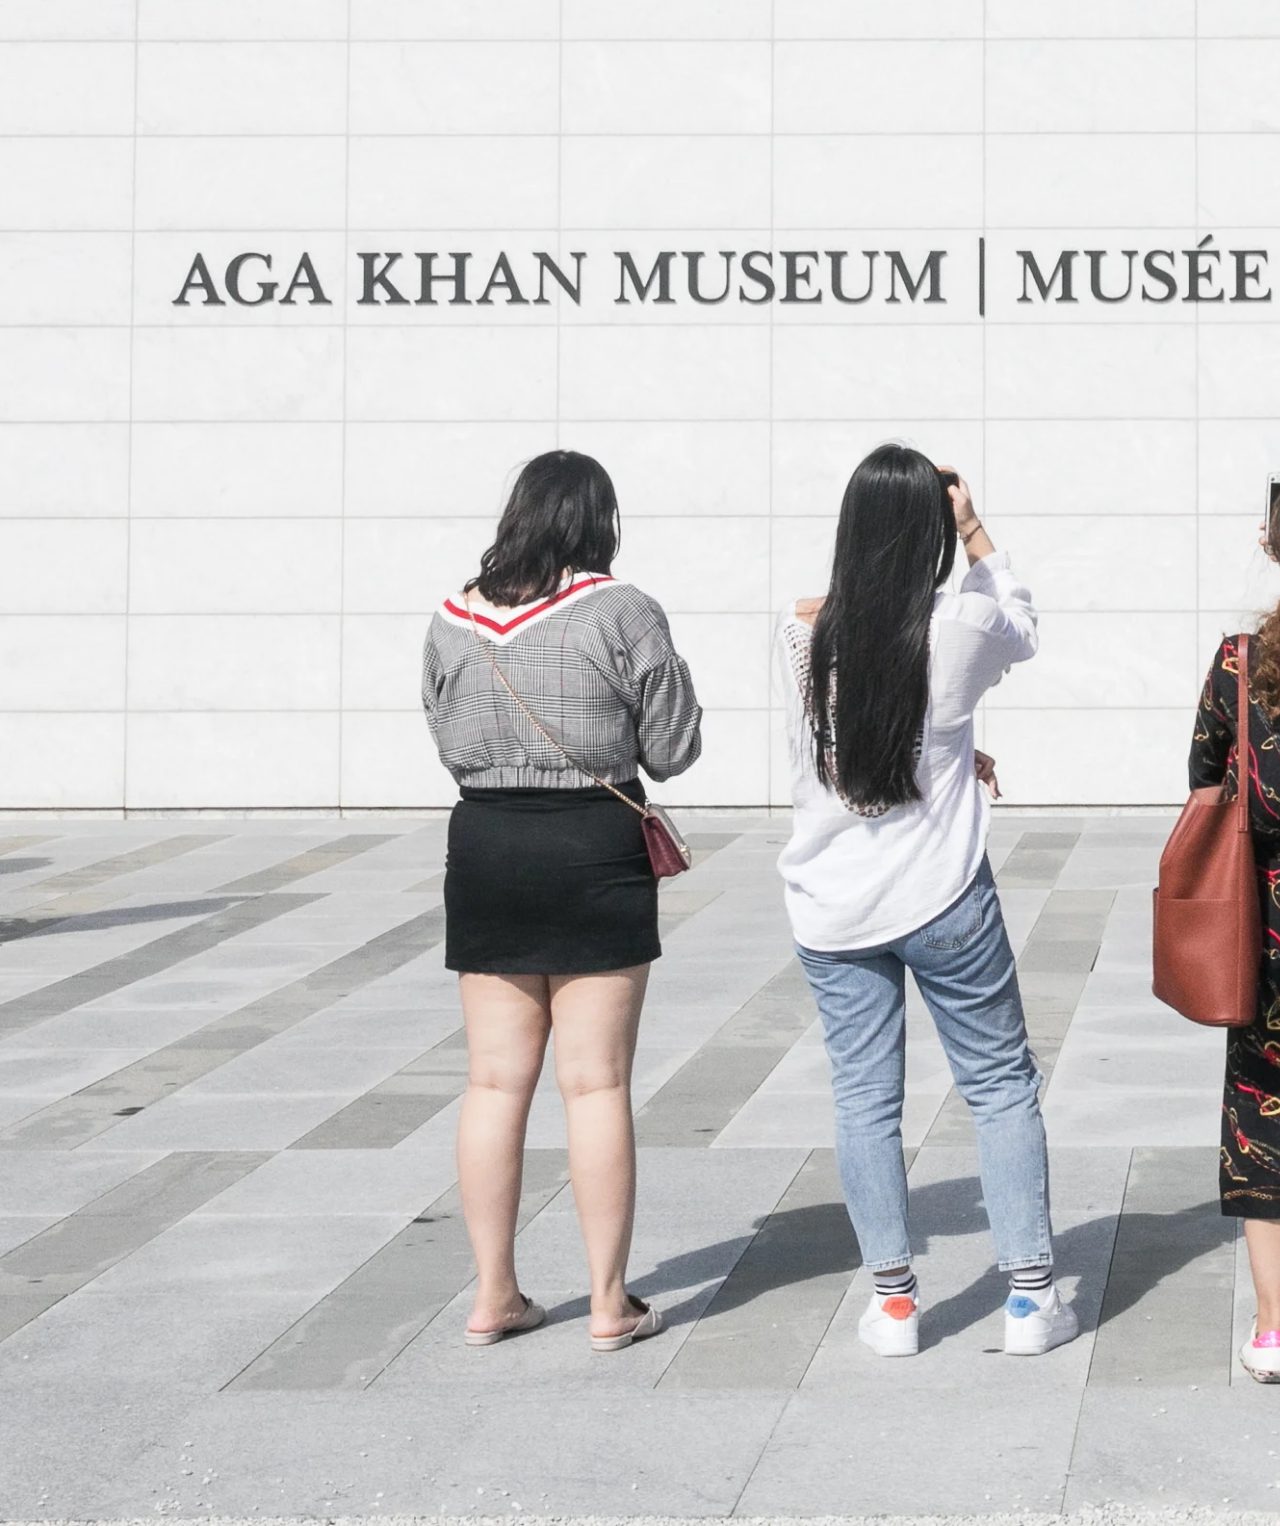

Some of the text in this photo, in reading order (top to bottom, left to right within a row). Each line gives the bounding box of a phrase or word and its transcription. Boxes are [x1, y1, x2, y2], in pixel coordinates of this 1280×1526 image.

[172, 252, 332, 305] AGA
[357, 251, 586, 304] KHAN
[614, 250, 947, 303] MUSEUM
[1016, 234, 1272, 302] MUSÉE
